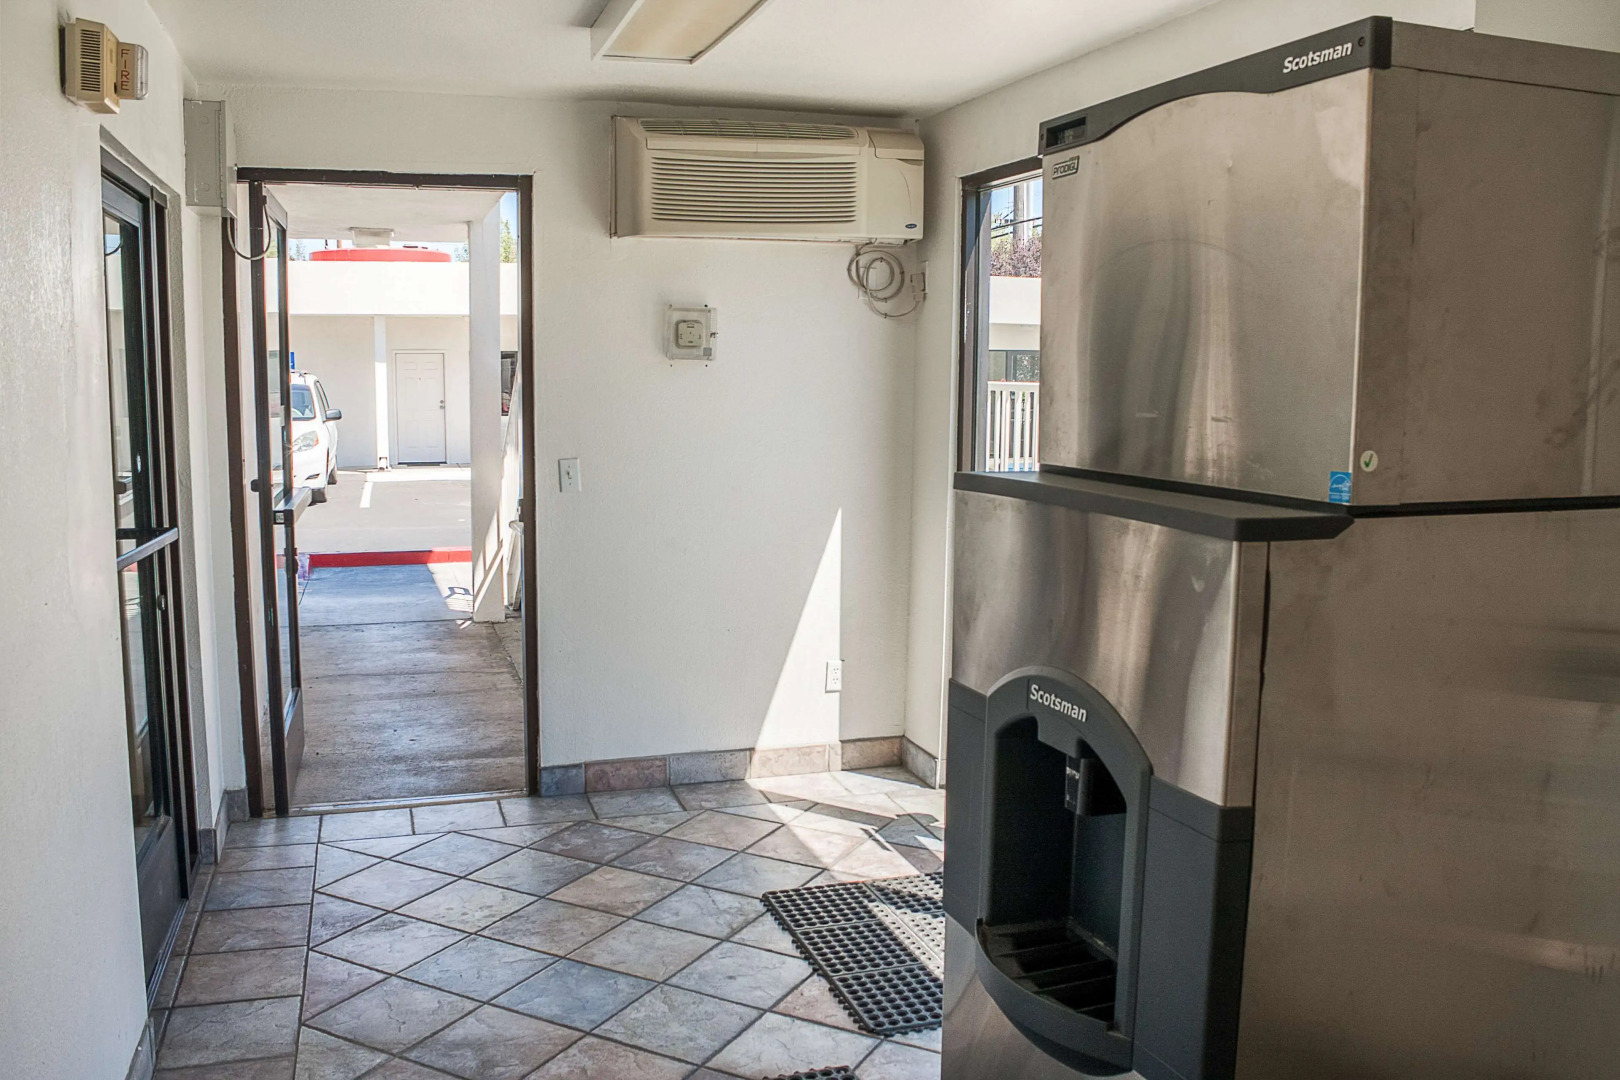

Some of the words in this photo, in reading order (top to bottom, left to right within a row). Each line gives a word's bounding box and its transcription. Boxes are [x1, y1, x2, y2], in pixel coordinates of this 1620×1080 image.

[120, 48, 131, 91] FIRE
[1282, 42, 1353, 74] Scotsman
[1029, 683, 1087, 722] Scotsman
